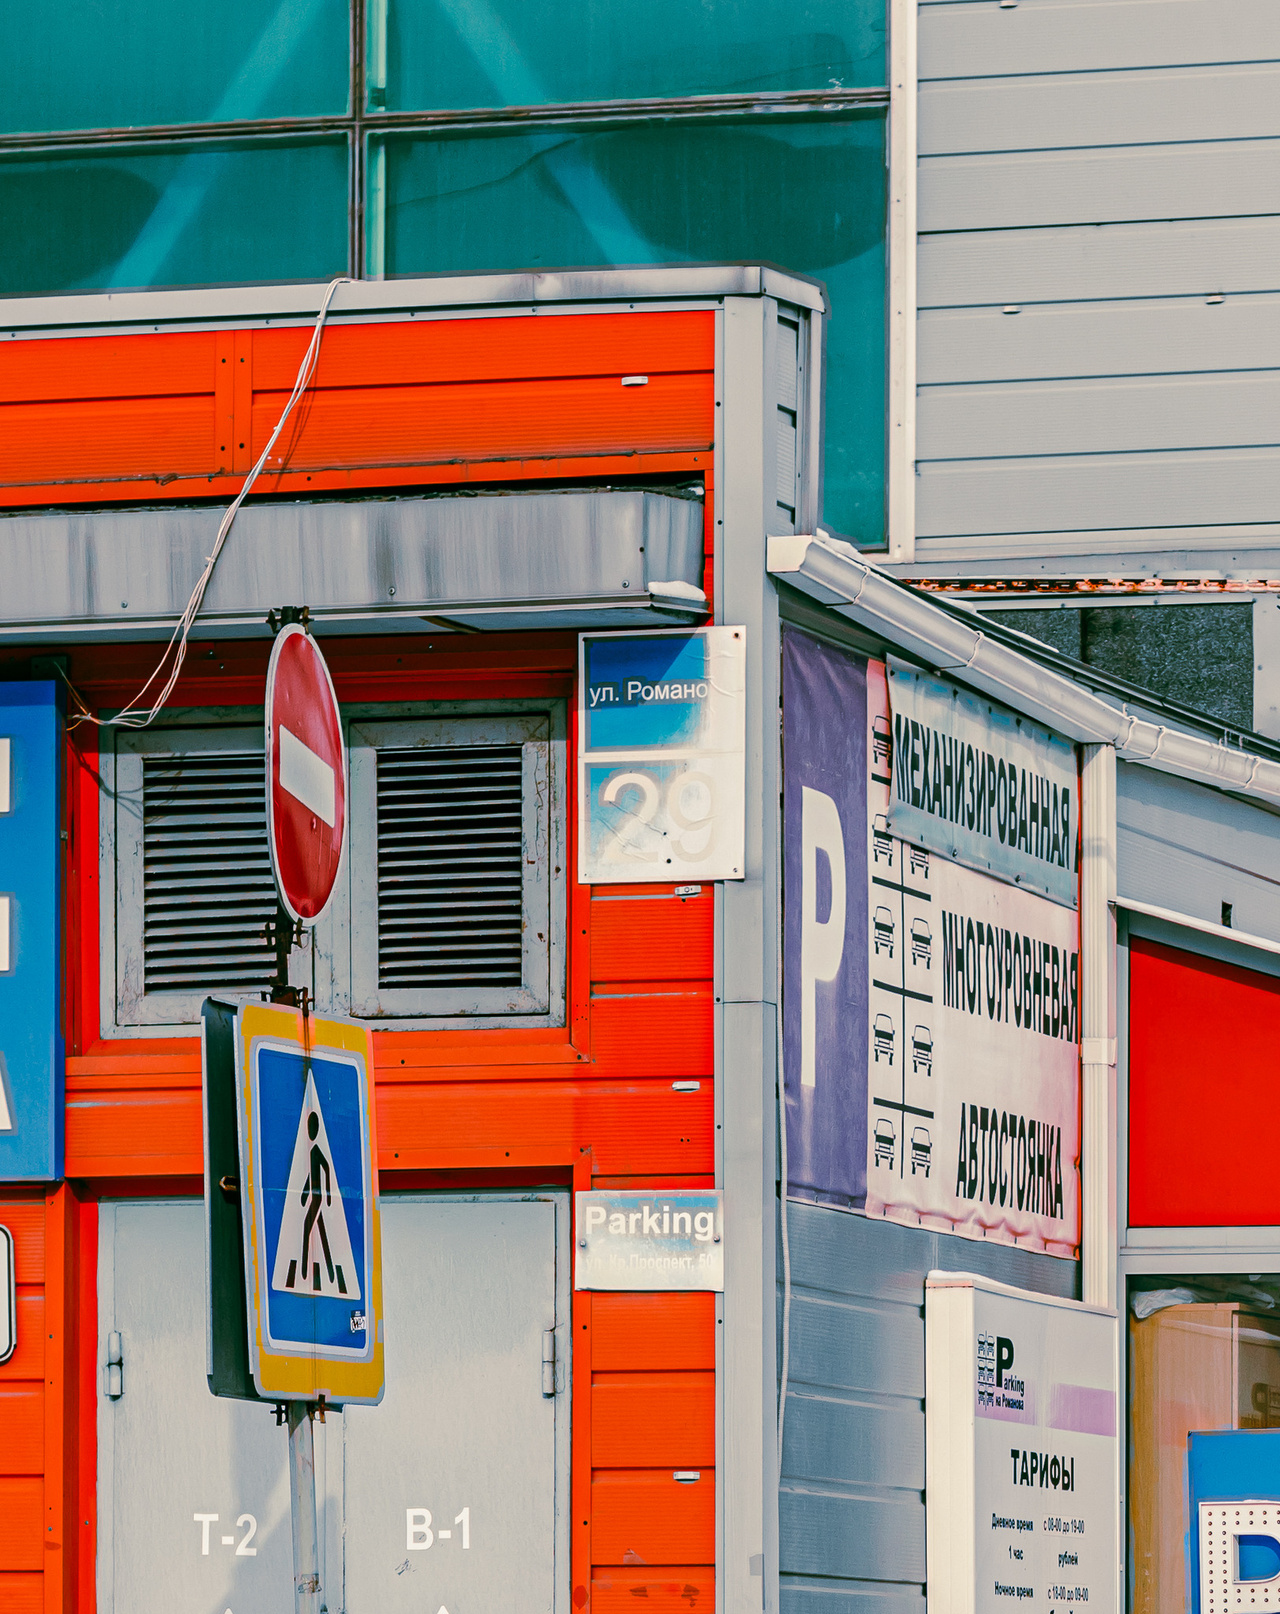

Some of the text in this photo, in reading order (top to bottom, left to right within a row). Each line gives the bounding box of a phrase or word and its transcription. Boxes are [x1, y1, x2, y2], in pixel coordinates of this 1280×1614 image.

[588, 681, 708, 708] ул. Романо
[895, 713, 1071, 871] МЕХАНИЗИРОВАННАЯ
[603, 771, 717, 863] 29
[941, 909, 1079, 1045] МНОГОУРОВНЕВАЯ
[955, 1102, 1065, 1220] АВТОСТОЯНКА
[585, 1205, 714, 1242] Parking
[698, 1253, 714, 1269] 50
[1002, 1393, 1025, 1411] Романова
[1010, 1448, 1075, 1492] ТАРИФЫ
[992, 1513, 1085, 1534] Дневное время с 08-00 до 19-00
[1008, 1545, 1078, 1568] 1 час рублей
[994, 1581, 1015, 1597] Ночное
[1016, 1586, 1034, 1601] время
[1048, 1588, 1052, 1600] с
[1066, 1590, 1074, 1603] до
[1075, 1587, 1089, 1602] 09-00
